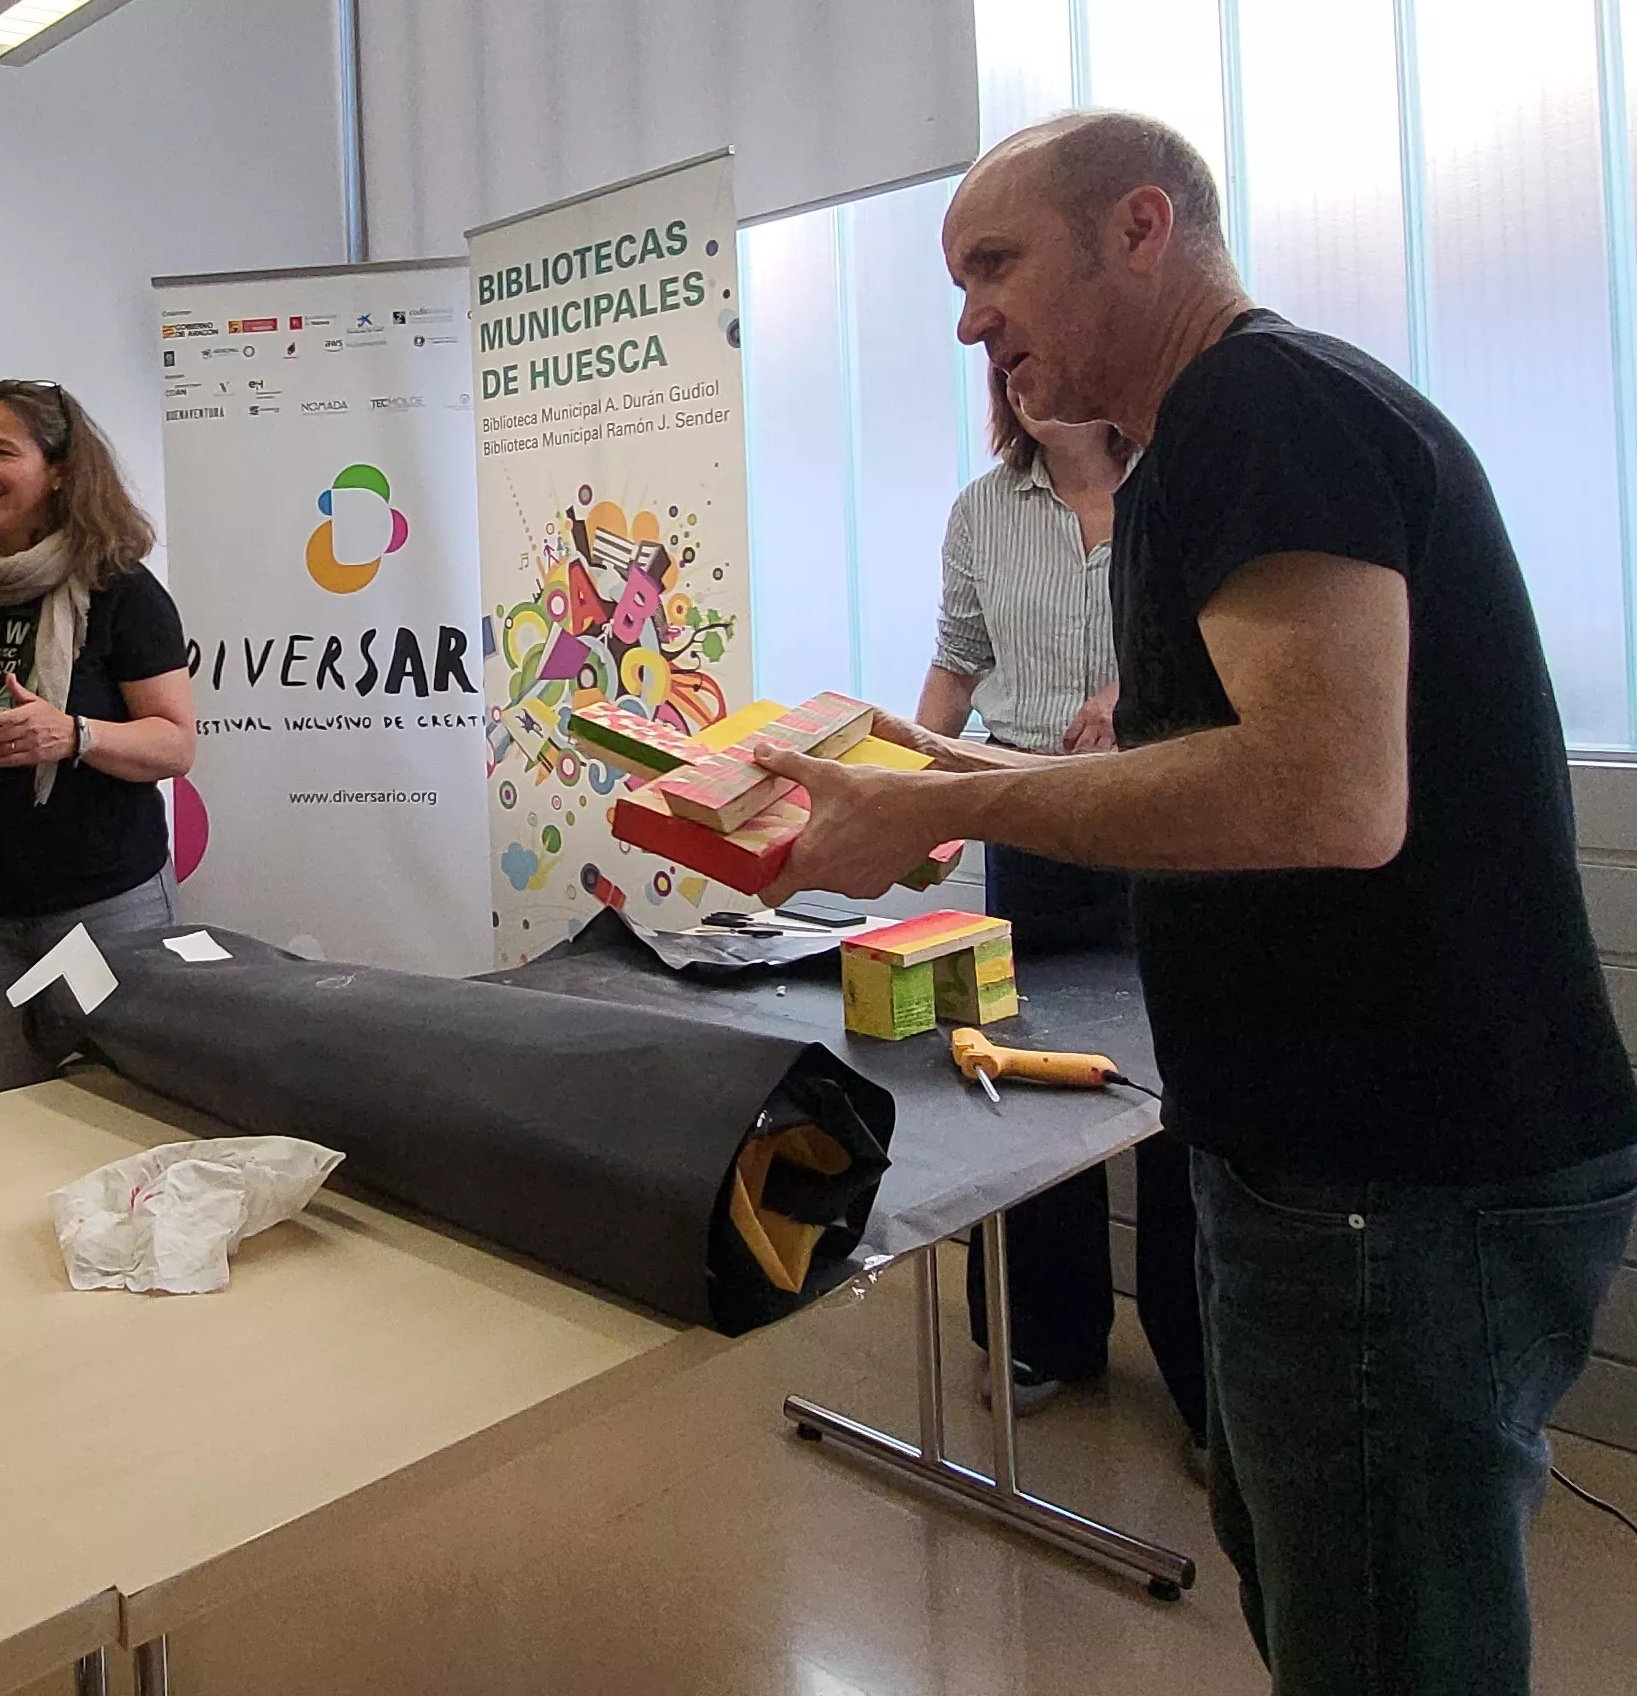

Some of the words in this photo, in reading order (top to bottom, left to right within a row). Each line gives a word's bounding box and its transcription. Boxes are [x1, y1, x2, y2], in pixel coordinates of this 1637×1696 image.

[478, 220, 688, 305] BIBLIOTECAS
[480, 271, 705, 353] MUNICIPALES
[482, 364, 519, 400] DE
[530, 335, 668, 391] HUESCA
[483, 413, 537, 432] Biblioteca
[541, 398, 602, 423] Municipal
[604, 396, 619, 413] A.
[623, 389, 664, 410] Durán
[669, 379, 719, 402] Gudiol
[483, 437, 539, 456] Biblioteca
[542, 423, 603, 447] Municipal
[606, 417, 654, 438] Ramón
[657, 413, 671, 431] J.
[675, 408, 730, 428] Sender
[284, 715, 372, 731] INCLUSIVO
[383, 715, 405, 729] DE
[289, 789, 437, 805] www.diversario.org
